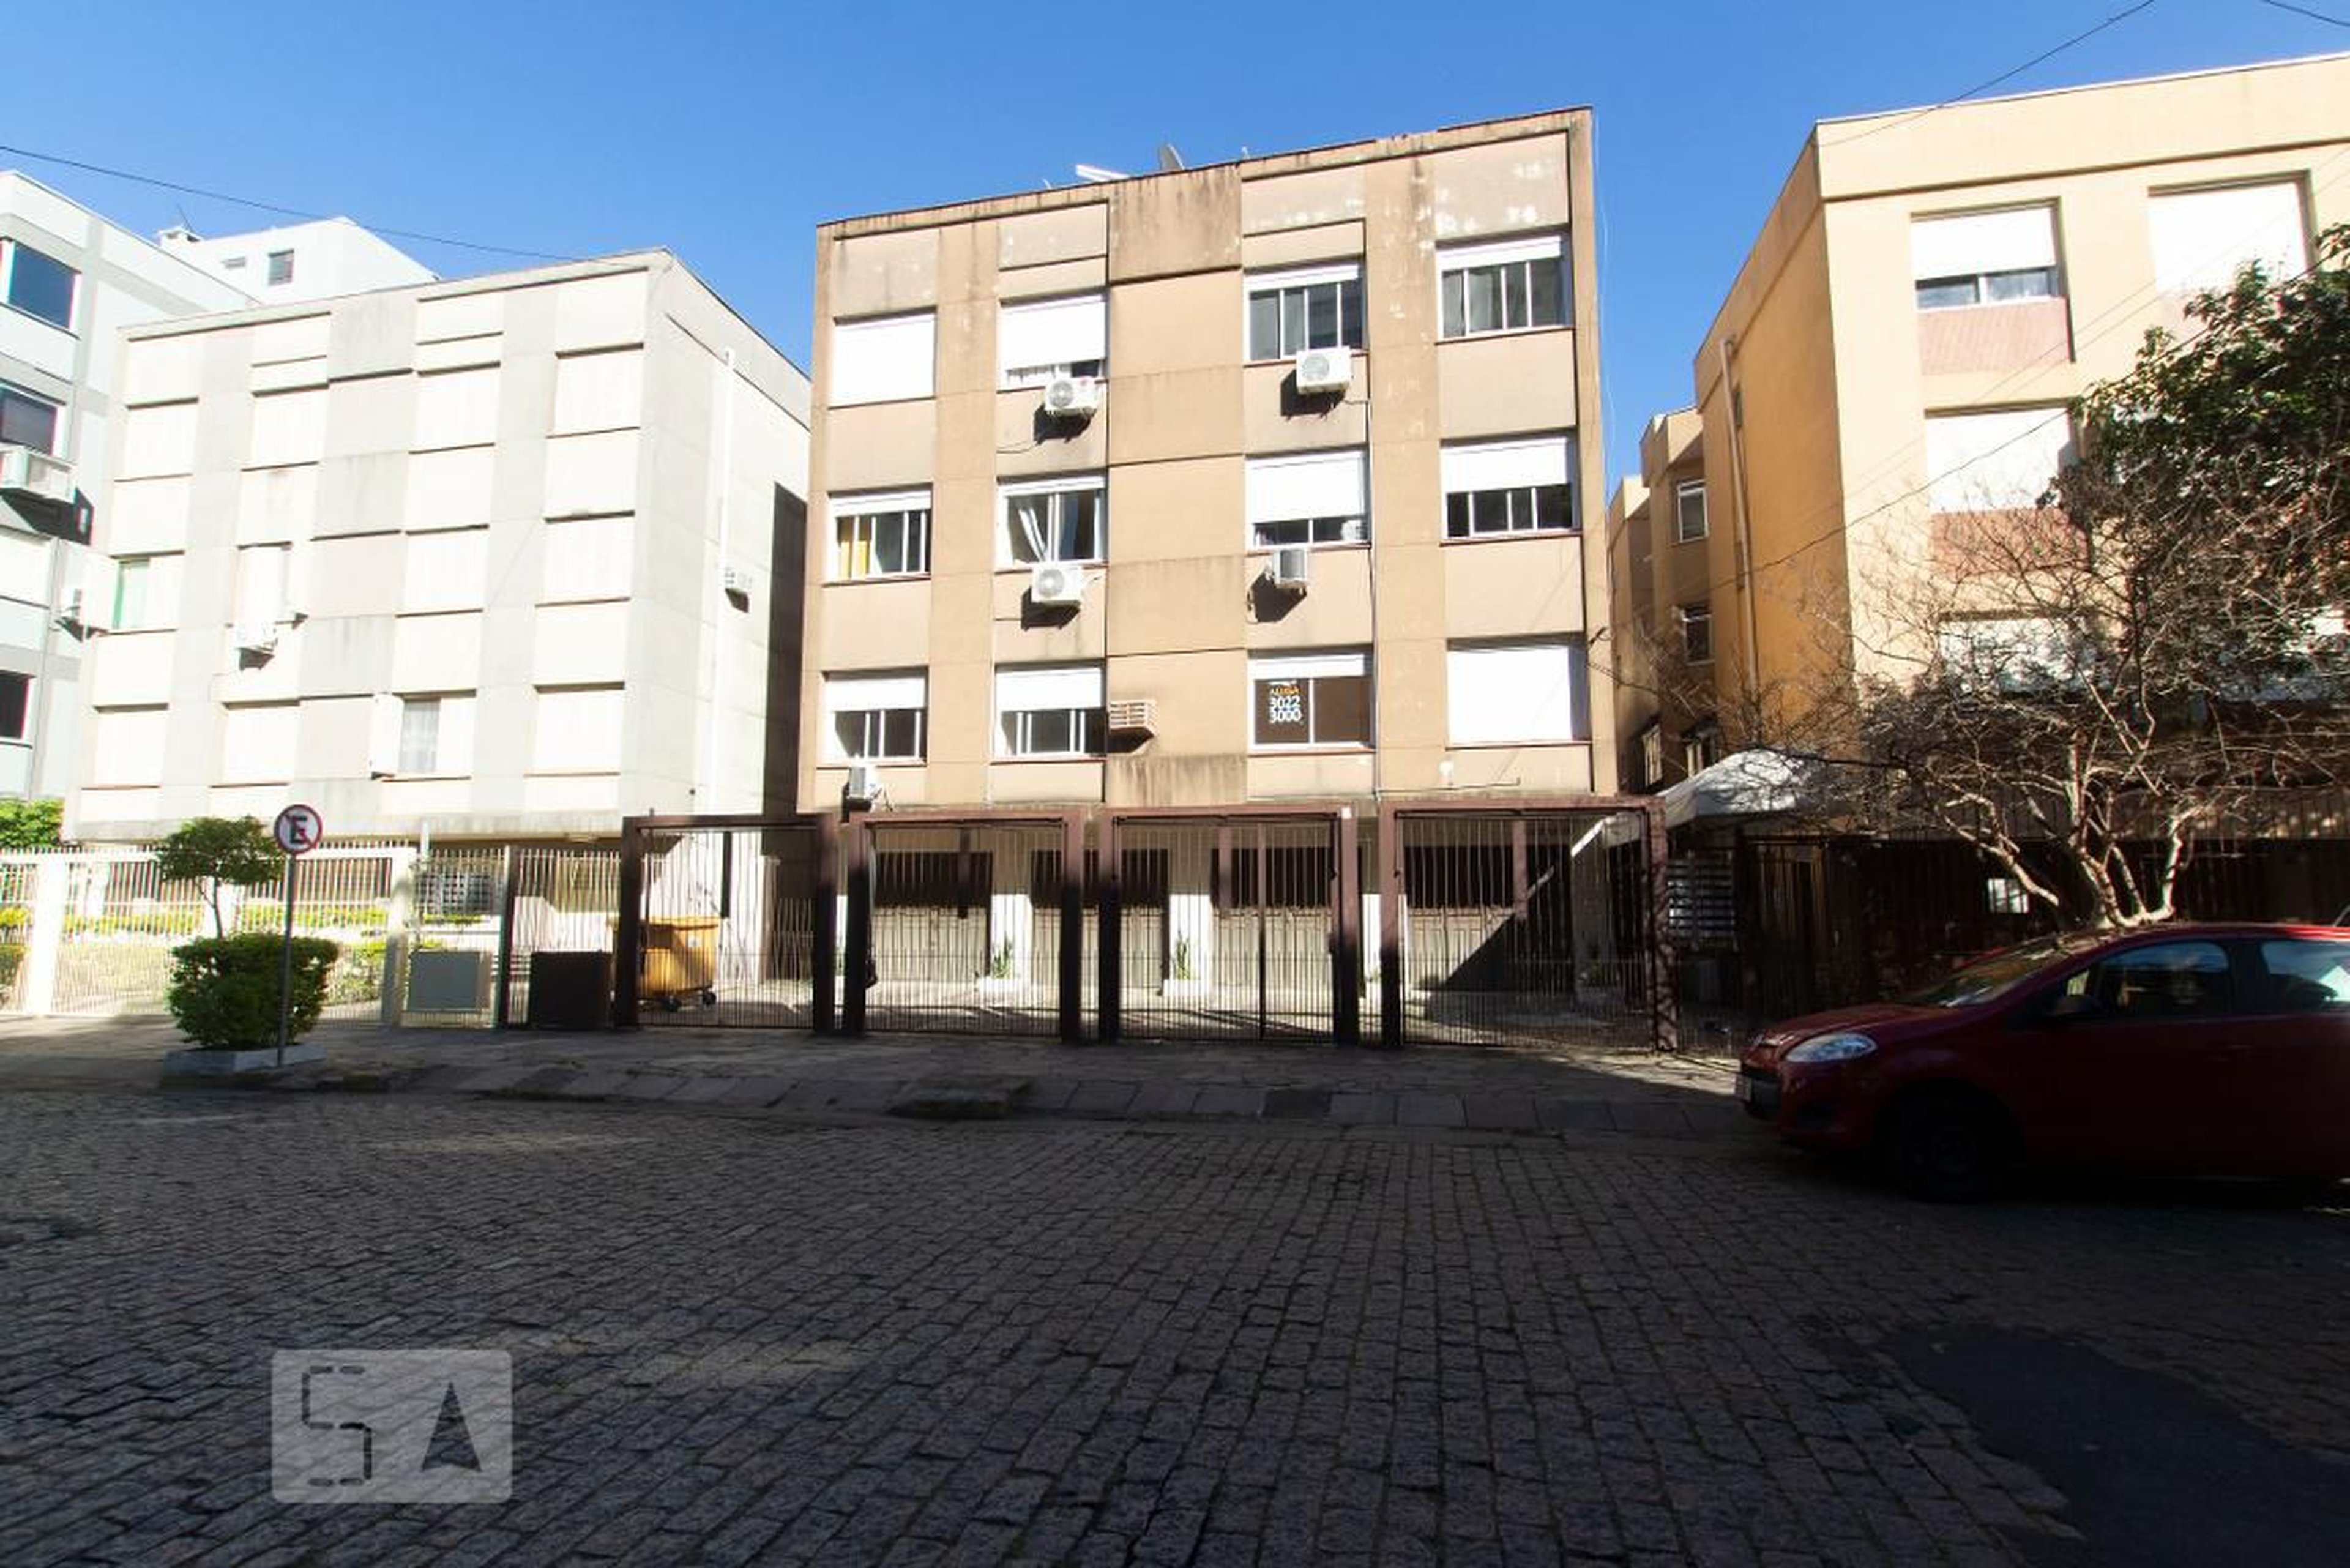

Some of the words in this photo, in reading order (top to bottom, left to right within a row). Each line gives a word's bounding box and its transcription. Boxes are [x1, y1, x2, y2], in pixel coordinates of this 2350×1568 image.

[1270, 695, 1300, 709] 3022
[1269, 708, 1302, 723] 3000
[289, 815, 307, 844] E
